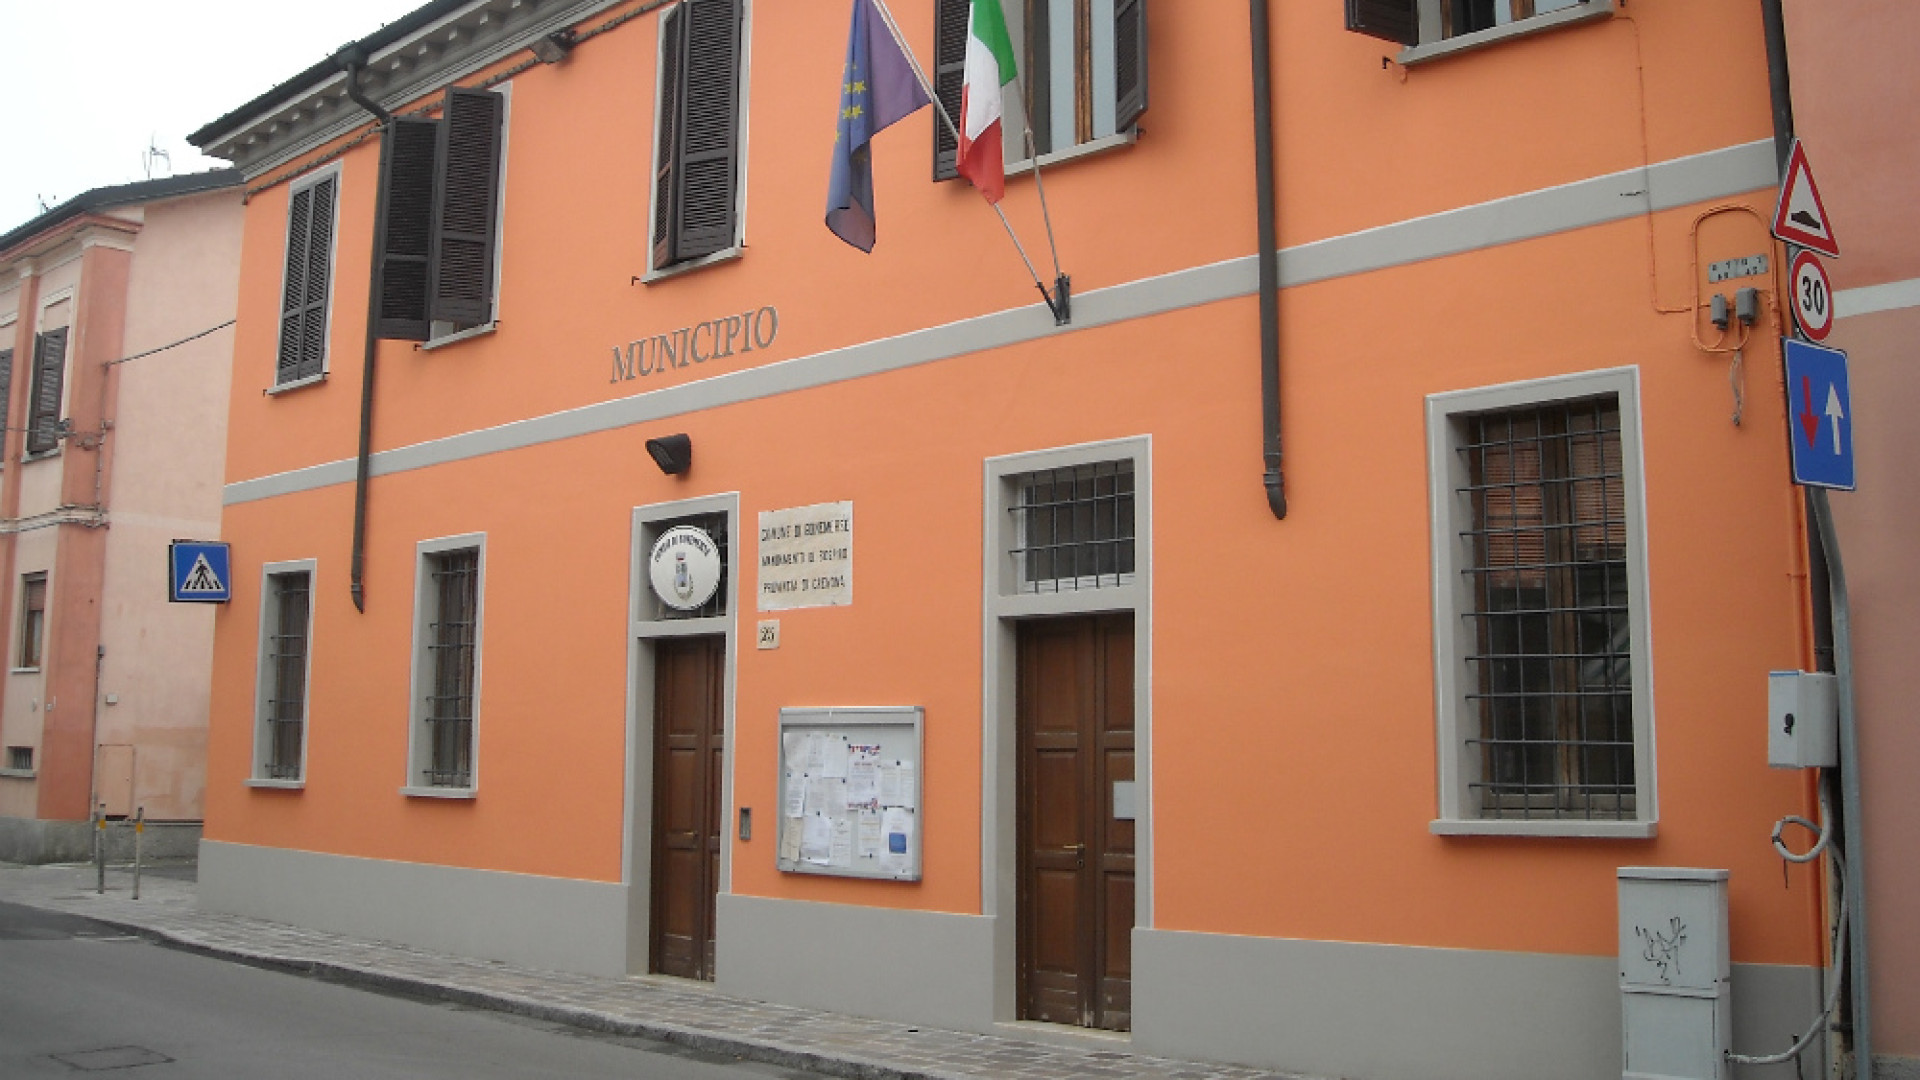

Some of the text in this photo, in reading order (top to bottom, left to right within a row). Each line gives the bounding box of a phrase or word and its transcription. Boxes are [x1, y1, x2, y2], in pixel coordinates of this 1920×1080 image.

[1802, 275, 1825, 315] 30
[610, 304, 779, 385] MUNICIPIO
[794, 524, 802, 538] DI
